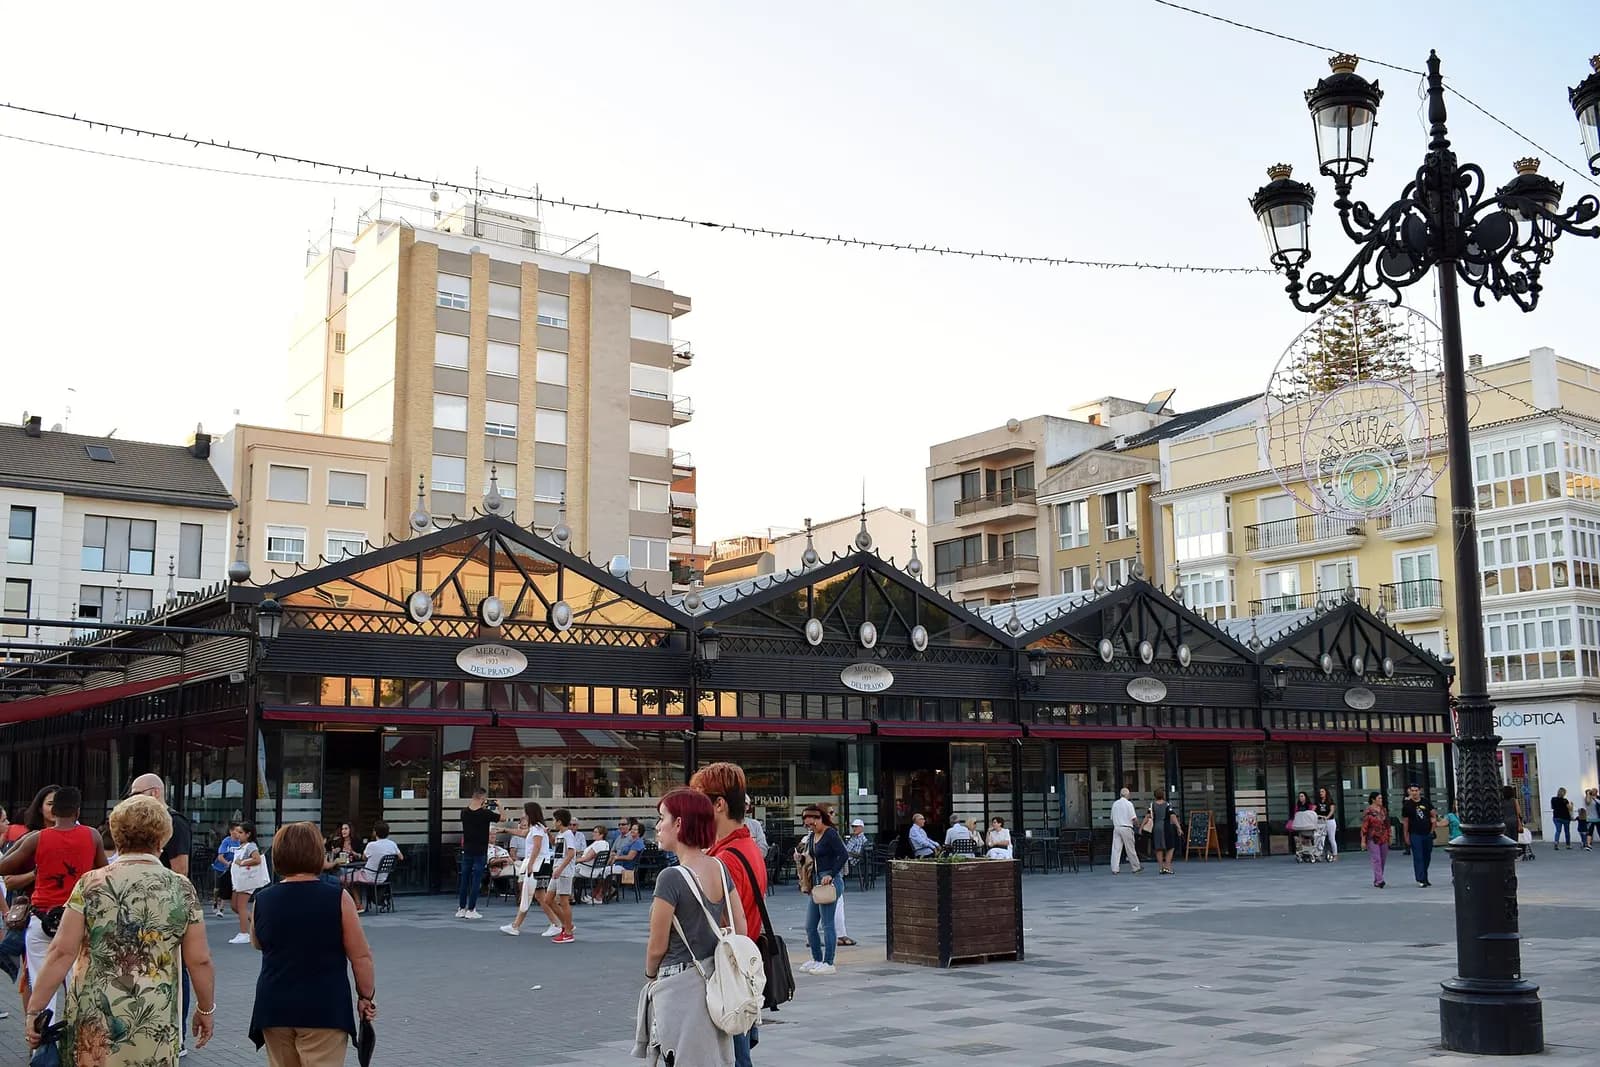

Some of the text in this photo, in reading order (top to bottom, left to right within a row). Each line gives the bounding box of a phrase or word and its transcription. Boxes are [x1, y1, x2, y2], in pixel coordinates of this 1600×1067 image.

[475, 647, 509, 657] MERCAT
[470, 665, 515, 676] DEL PRADO
[754, 795, 788, 805] PRADO
